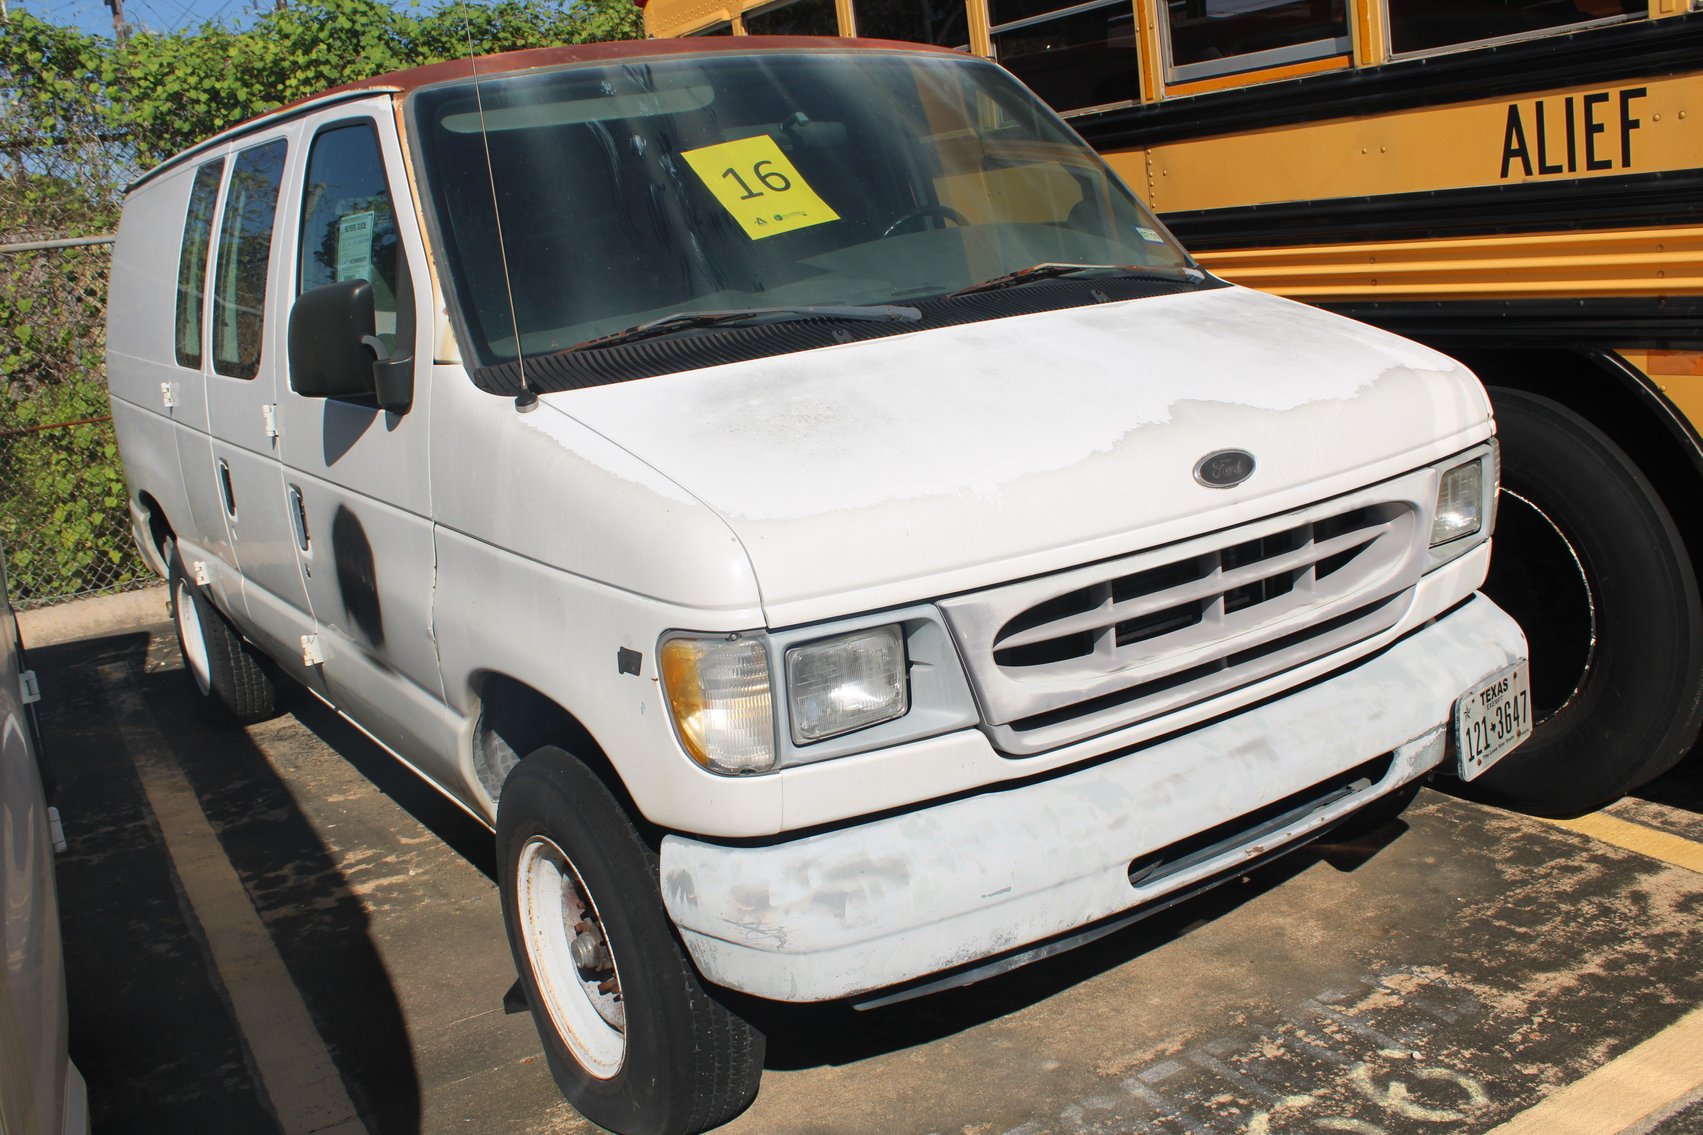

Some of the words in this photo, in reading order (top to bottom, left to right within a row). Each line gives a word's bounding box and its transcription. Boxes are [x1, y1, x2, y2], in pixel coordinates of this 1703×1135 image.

[1500, 87, 1647, 178] ALIEF
[721, 160, 791, 200] 16
[1212, 458, 1243, 479] Ford
[1480, 678, 1509, 705] TEXAS
[1486, 695, 1504, 710] EXEMPT
